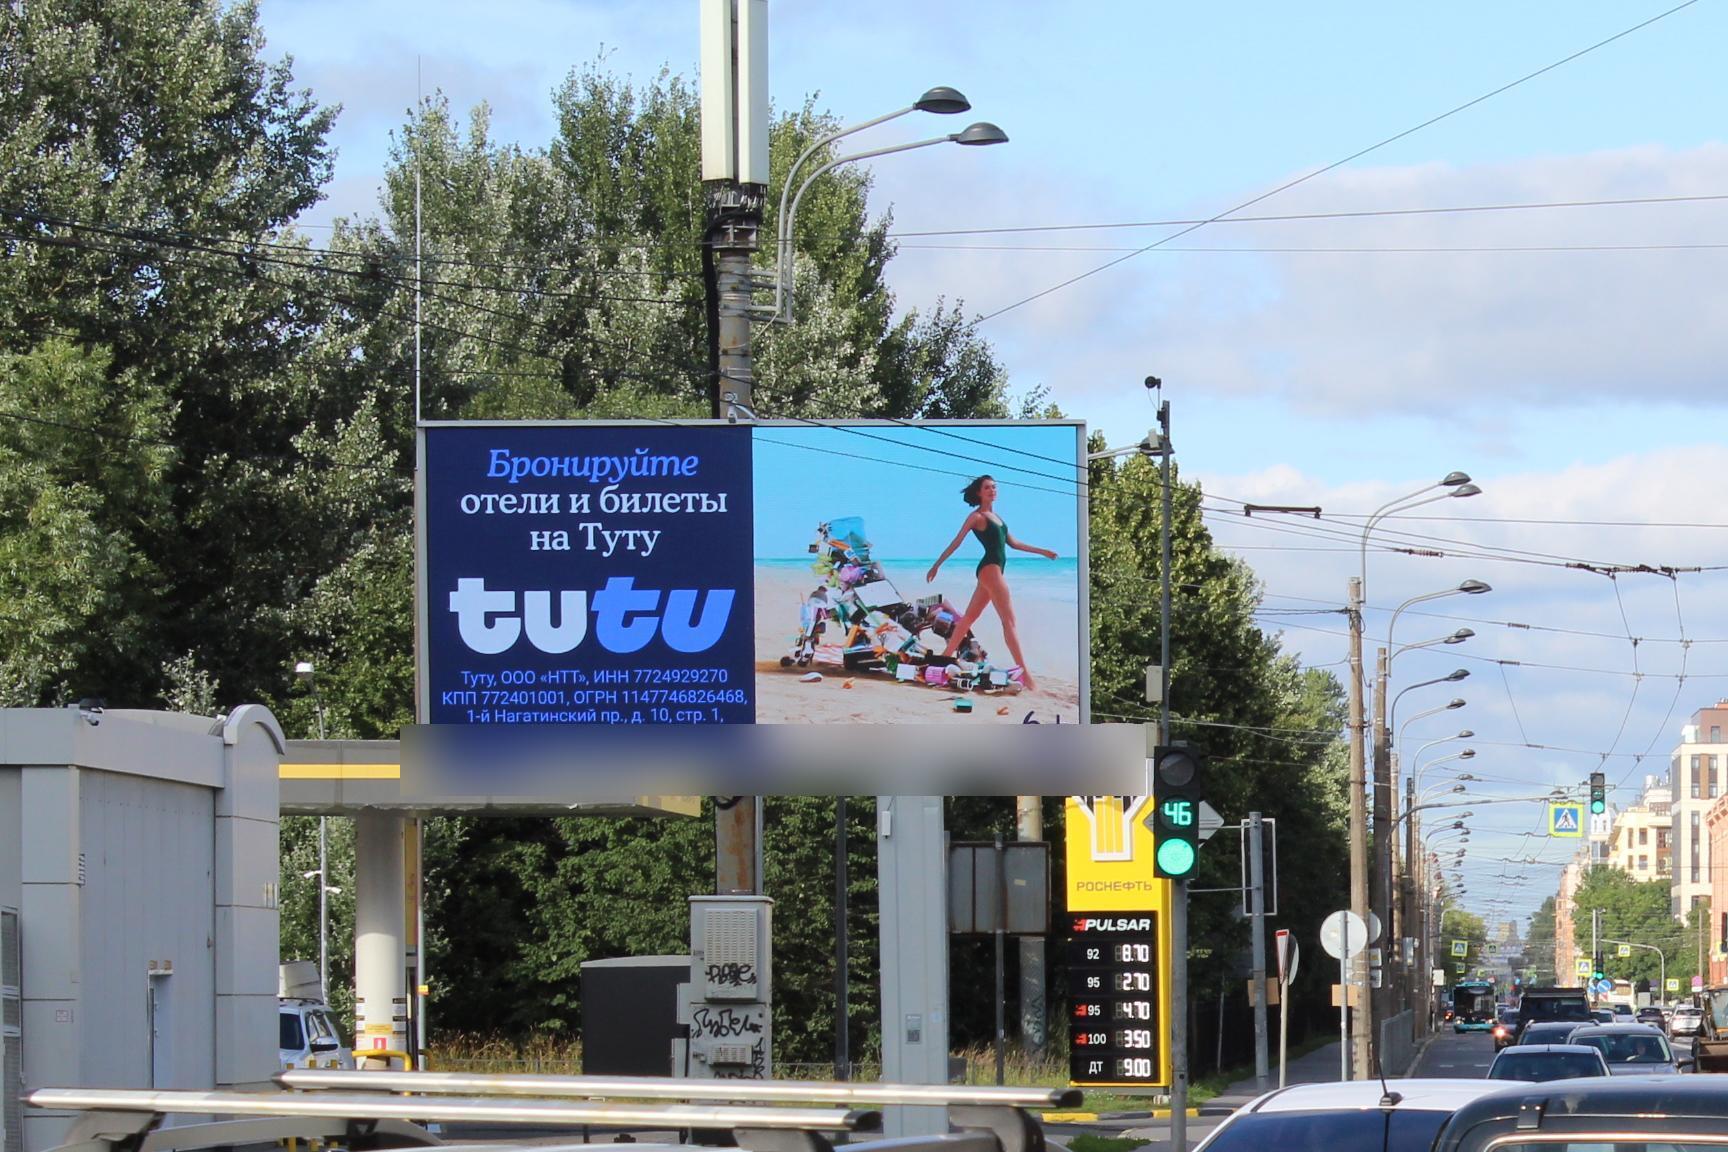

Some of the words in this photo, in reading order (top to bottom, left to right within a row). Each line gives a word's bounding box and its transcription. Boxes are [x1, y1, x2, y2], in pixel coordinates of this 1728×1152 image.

[487, 448, 698, 483] Бронируйте
[460, 492, 560, 514] отели
[569, 493, 590, 513] и
[600, 484, 728, 513] билеты
[530, 530, 570, 551] на
[579, 522, 661, 557] Туту
[449, 576, 735, 654] tutu
[461, 671, 497, 688] Туту,
[501, 671, 535, 684] ООО
[540, 670, 589, 687] «НТТ»,
[594, 670, 629, 684] ИНН
[634, 669, 728, 684] 7724929270
[442, 692, 477, 705] КПП
[482, 691, 570, 708] 772401001,
[574, 690, 617, 705] ОГРН
[623, 689, 748, 706] 1147746826468,
[467, 708, 490, 723] 1-й
[495, 708, 596, 723] Нагатинский
[601, 711, 628, 724] пр.,
[632, 711, 645, 724] д.
[652, 708, 672, 724] 10,
[676, 710, 706, 724] стр.
[712, 708, 724, 724] 1,
[1164, 802, 1192, 826] 46
[1076, 881, 1153, 892] РОСНЕФТЬ
[1085, 918, 1151, 931] PULSAR
[1087, 949, 1100, 960] 92
[1087, 977, 1100, 988] 95
[1088, 1005, 1101, 1016] 95
[1088, 1033, 1106, 1045] 100
[1089, 1062, 1103, 1074] ДТ
